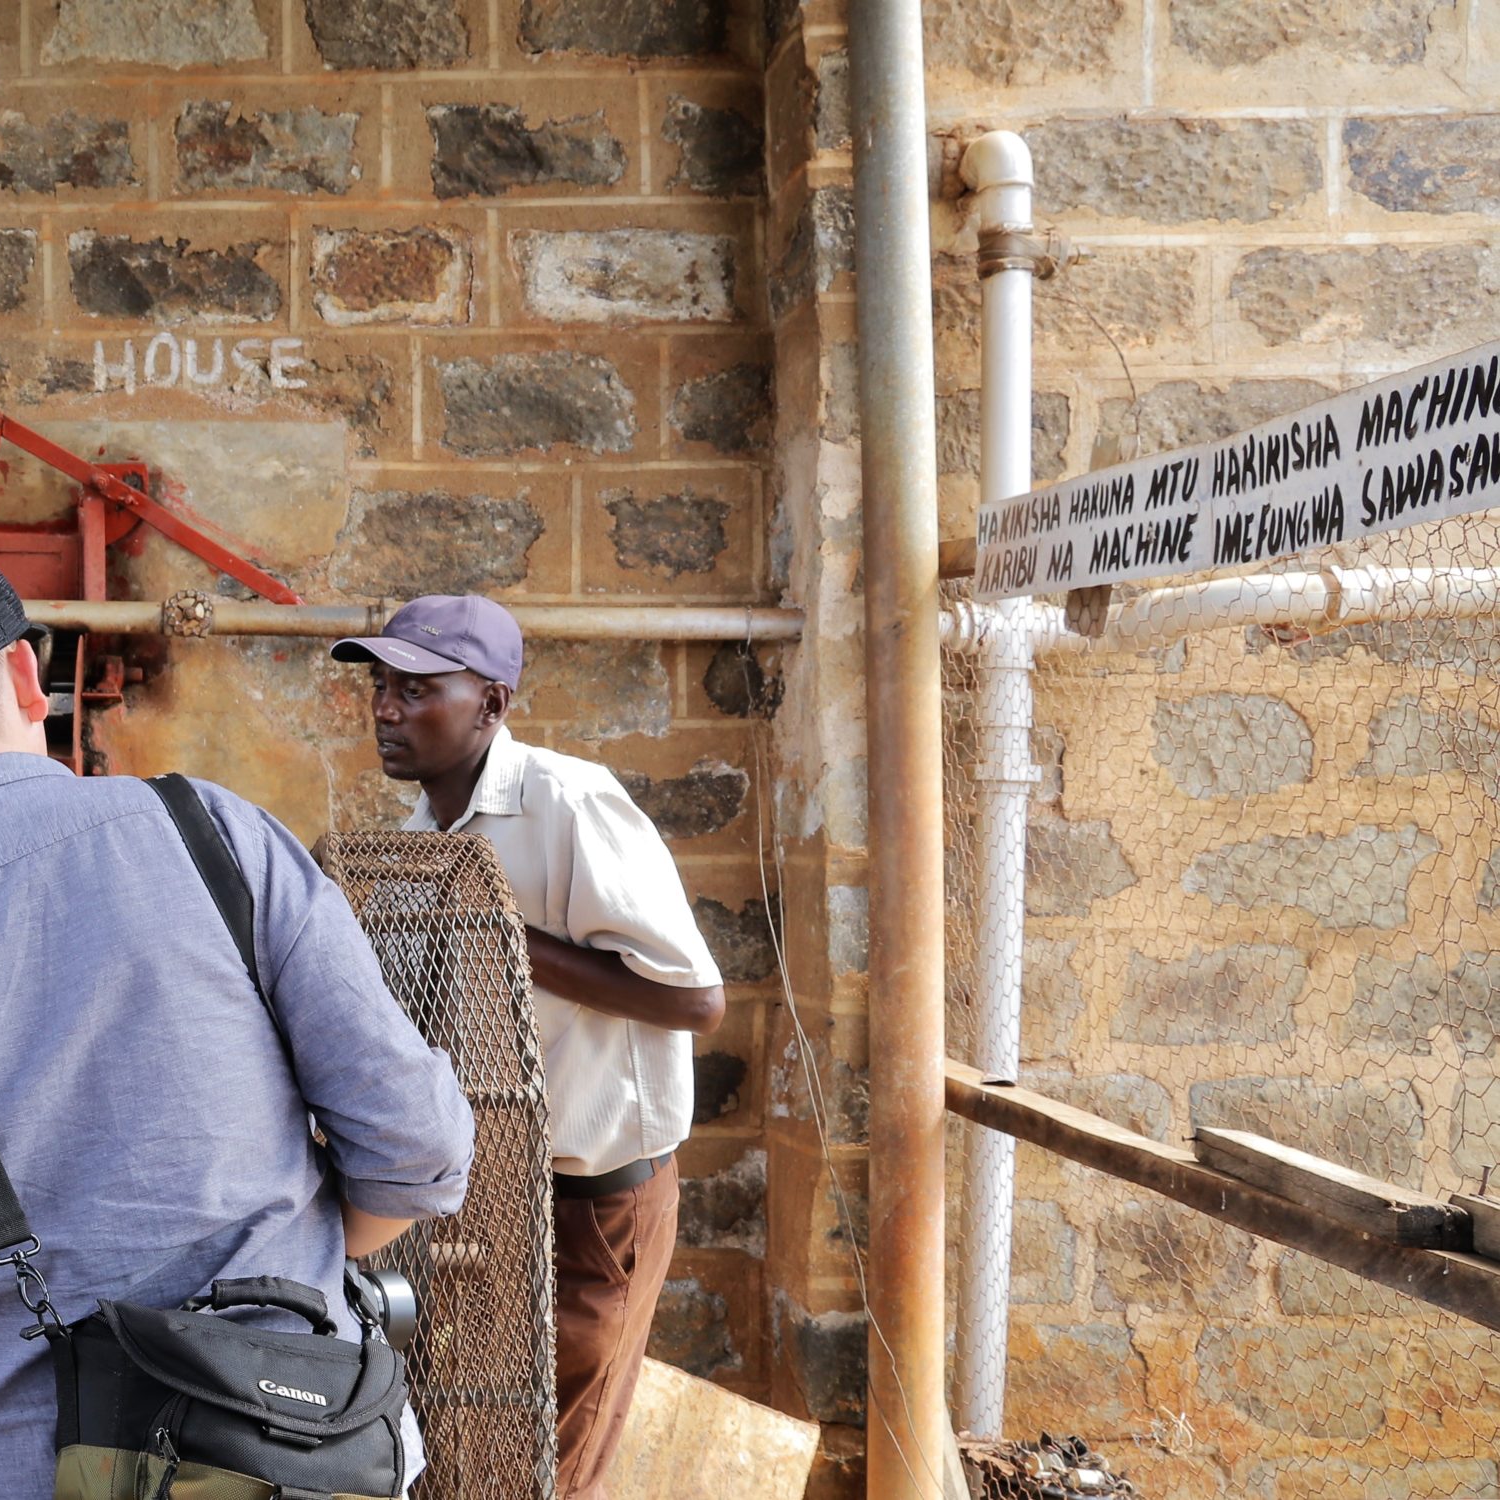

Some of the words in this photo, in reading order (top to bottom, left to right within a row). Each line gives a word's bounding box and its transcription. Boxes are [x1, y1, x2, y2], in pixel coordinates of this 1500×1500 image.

[94, 331, 308, 396] HOUSE
[978, 493, 1060, 545] HAKIKISHA
[1069, 473, 1134, 524] HAKUNA
[1145, 457, 1199, 511] MTU
[1212, 414, 1340, 498] HAKIKISHA
[978, 545, 1038, 593] KARIBU
[1047, 540, 1074, 582] NA
[1089, 513, 1199, 575] MACHINE
[1213, 483, 1344, 564] IMEFUNGWA
[257, 1379, 327, 1407] Canon
